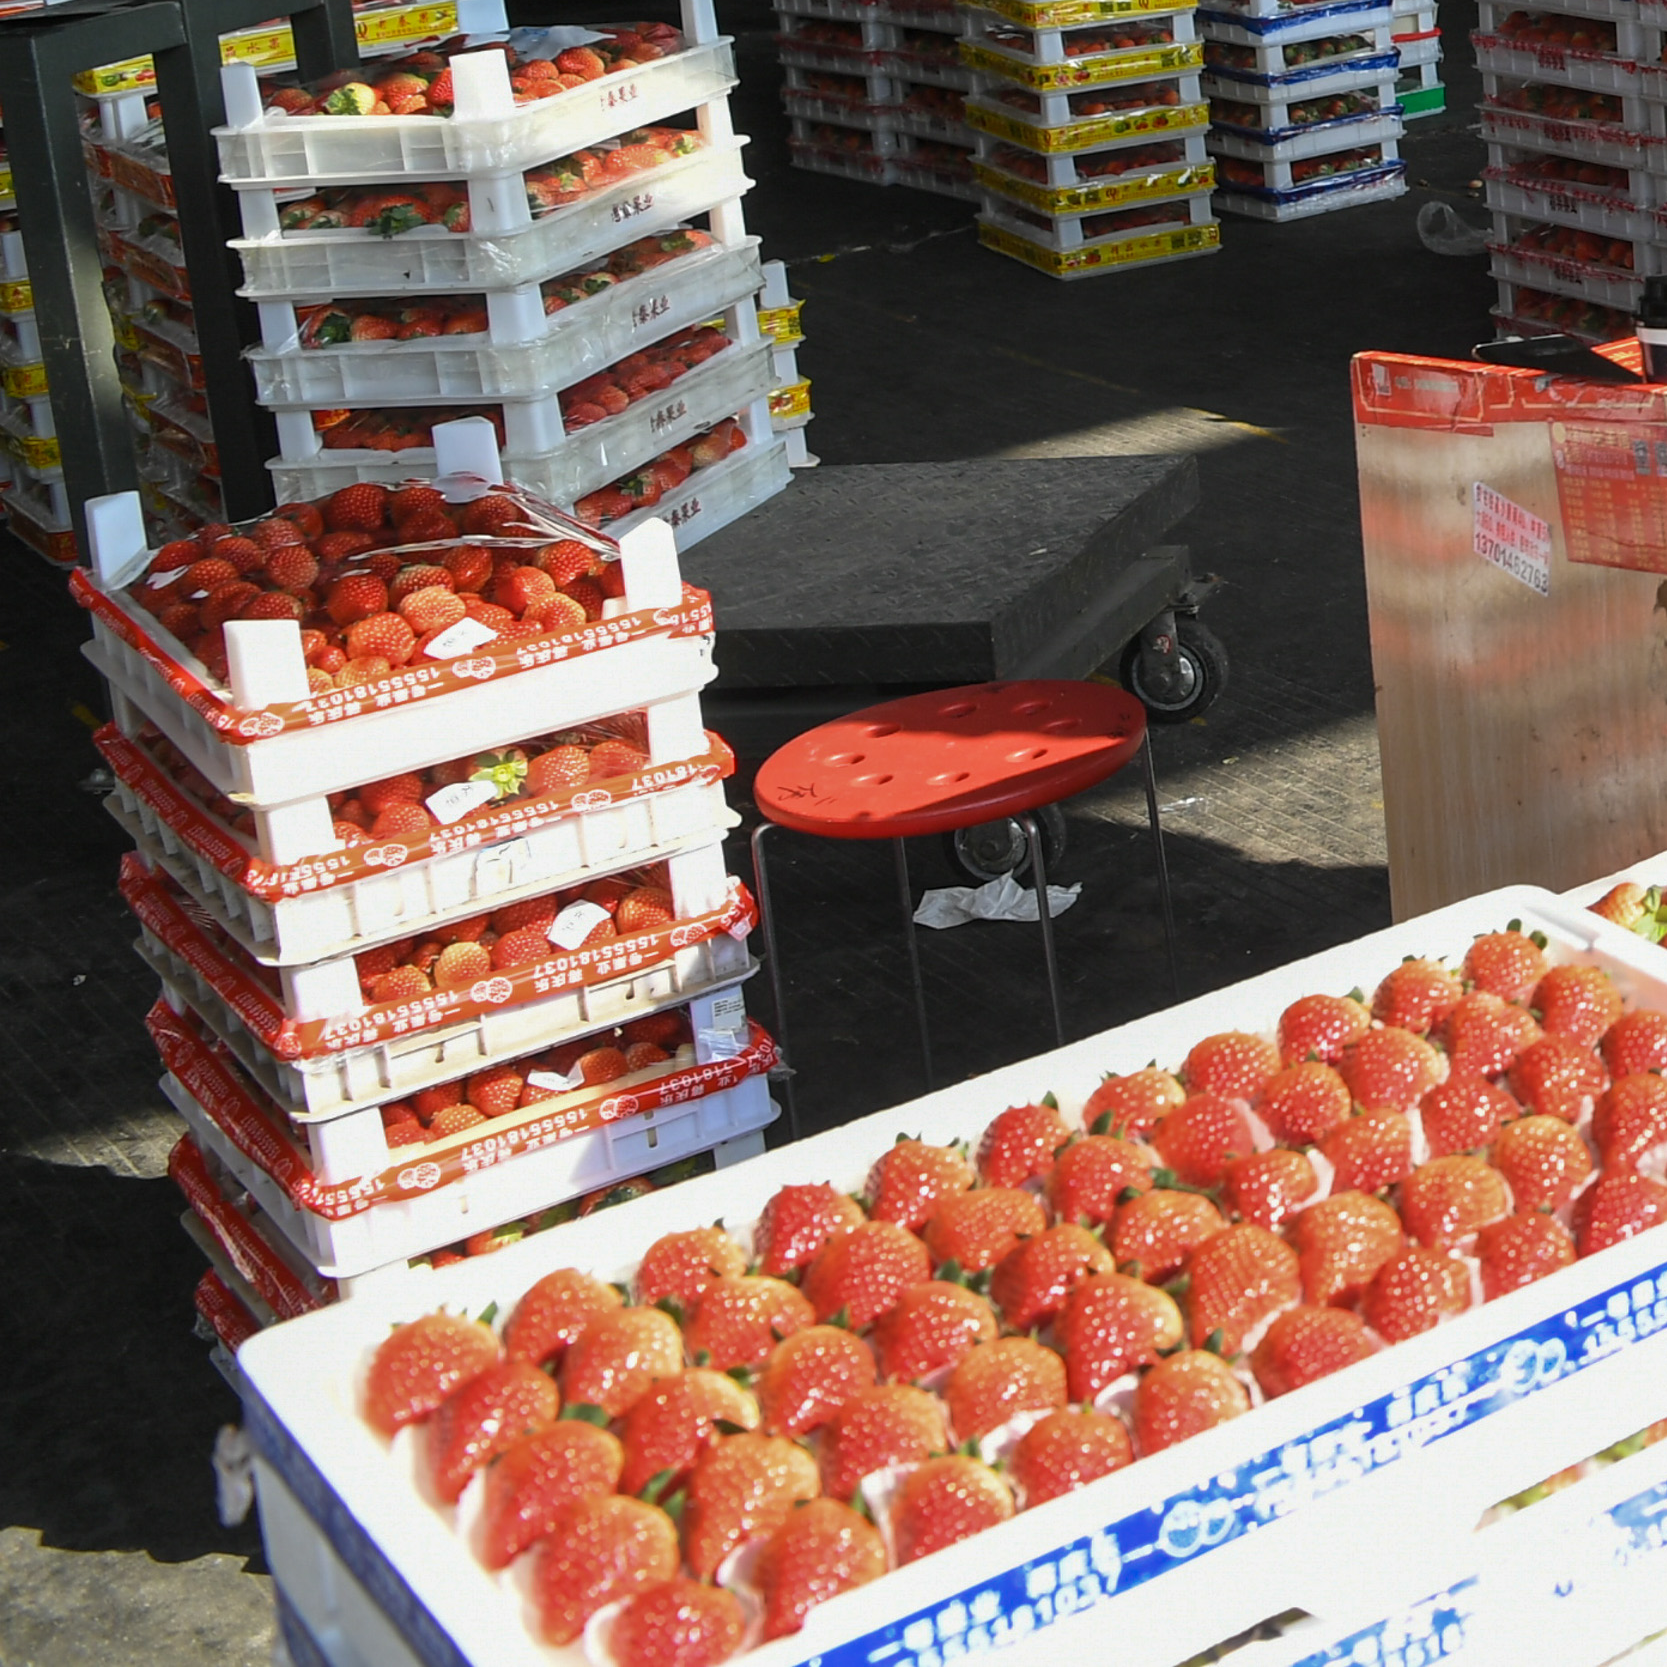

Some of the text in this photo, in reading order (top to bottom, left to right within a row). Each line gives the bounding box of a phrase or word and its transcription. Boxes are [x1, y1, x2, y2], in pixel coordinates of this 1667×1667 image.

[532, 932, 659, 979] 15555181037
[323, 988, 459, 1040] 15555181037
[460, 1107, 588, 1159] 15555181037
